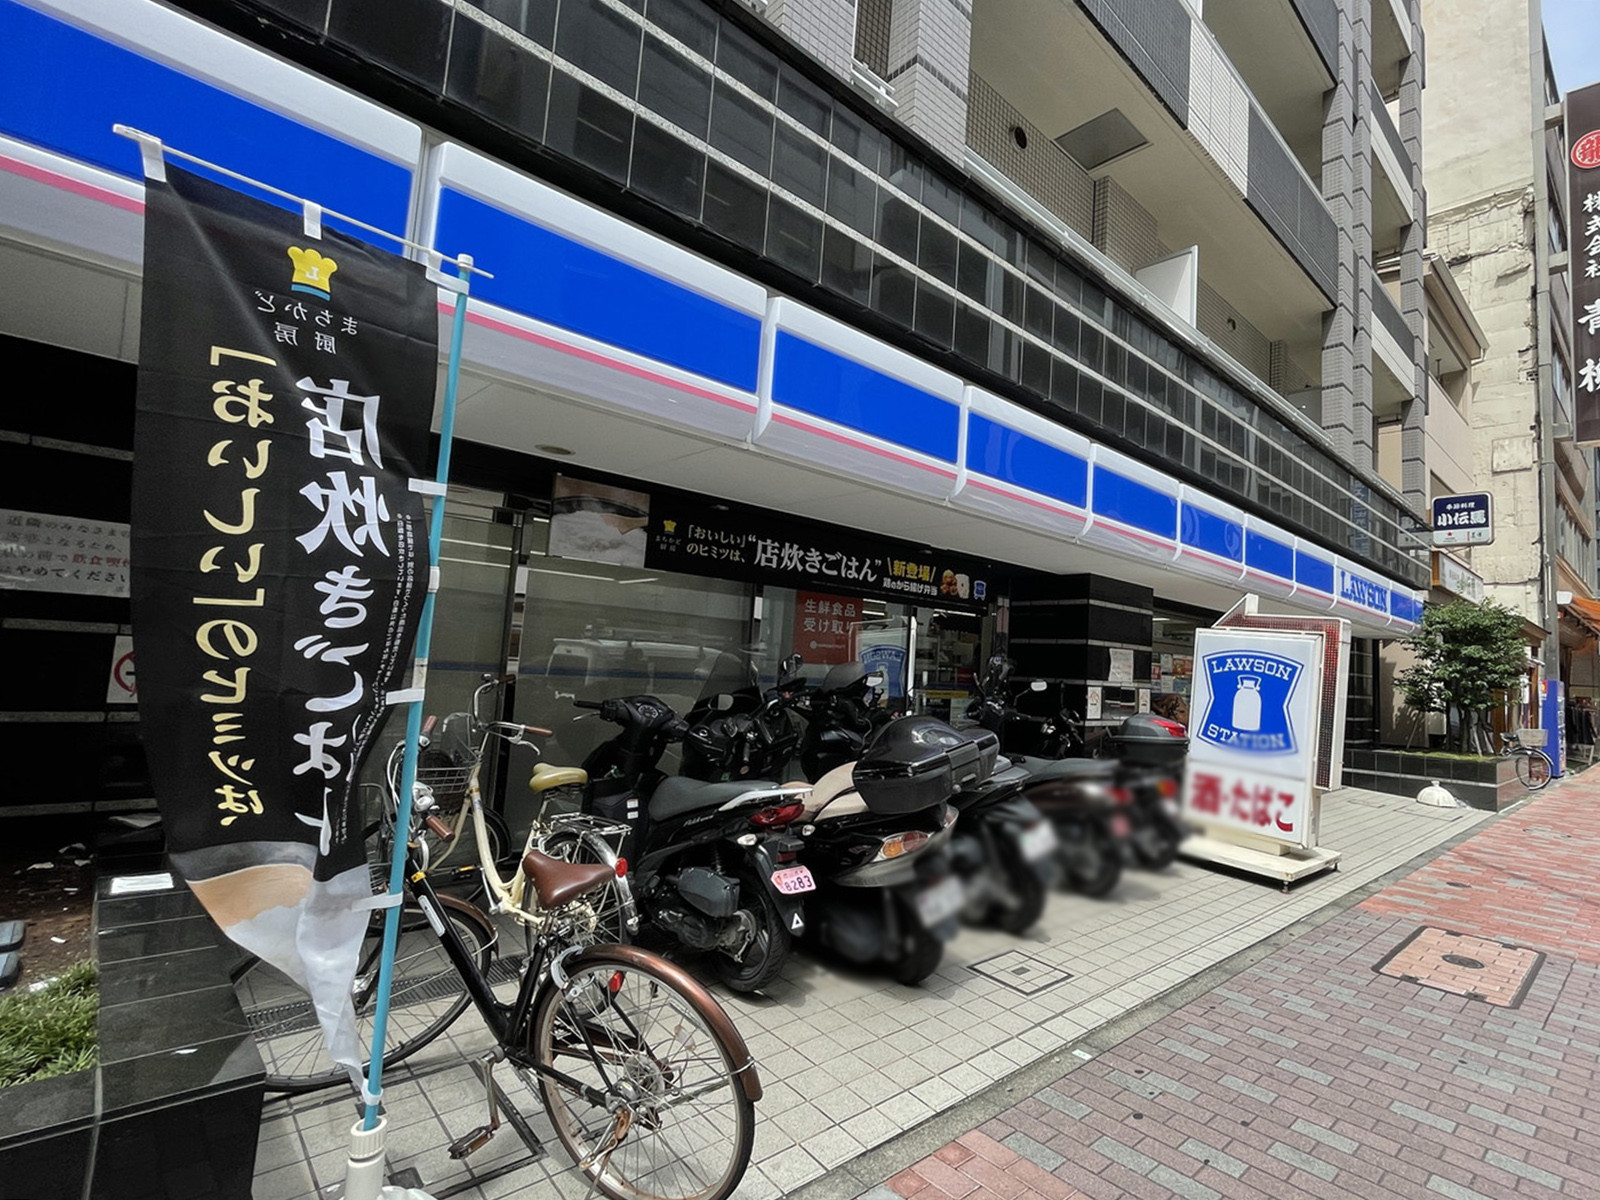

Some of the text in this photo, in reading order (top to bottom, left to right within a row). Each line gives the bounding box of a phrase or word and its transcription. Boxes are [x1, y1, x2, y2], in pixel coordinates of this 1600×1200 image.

[893, 560, 931, 581] 新登場
[1340, 570, 1388, 613] LAWSON
[804, 599, 856, 617] 生鮮食品
[1211, 658, 1293, 681] LAWSON
[1207, 724, 1286, 749] STATION
